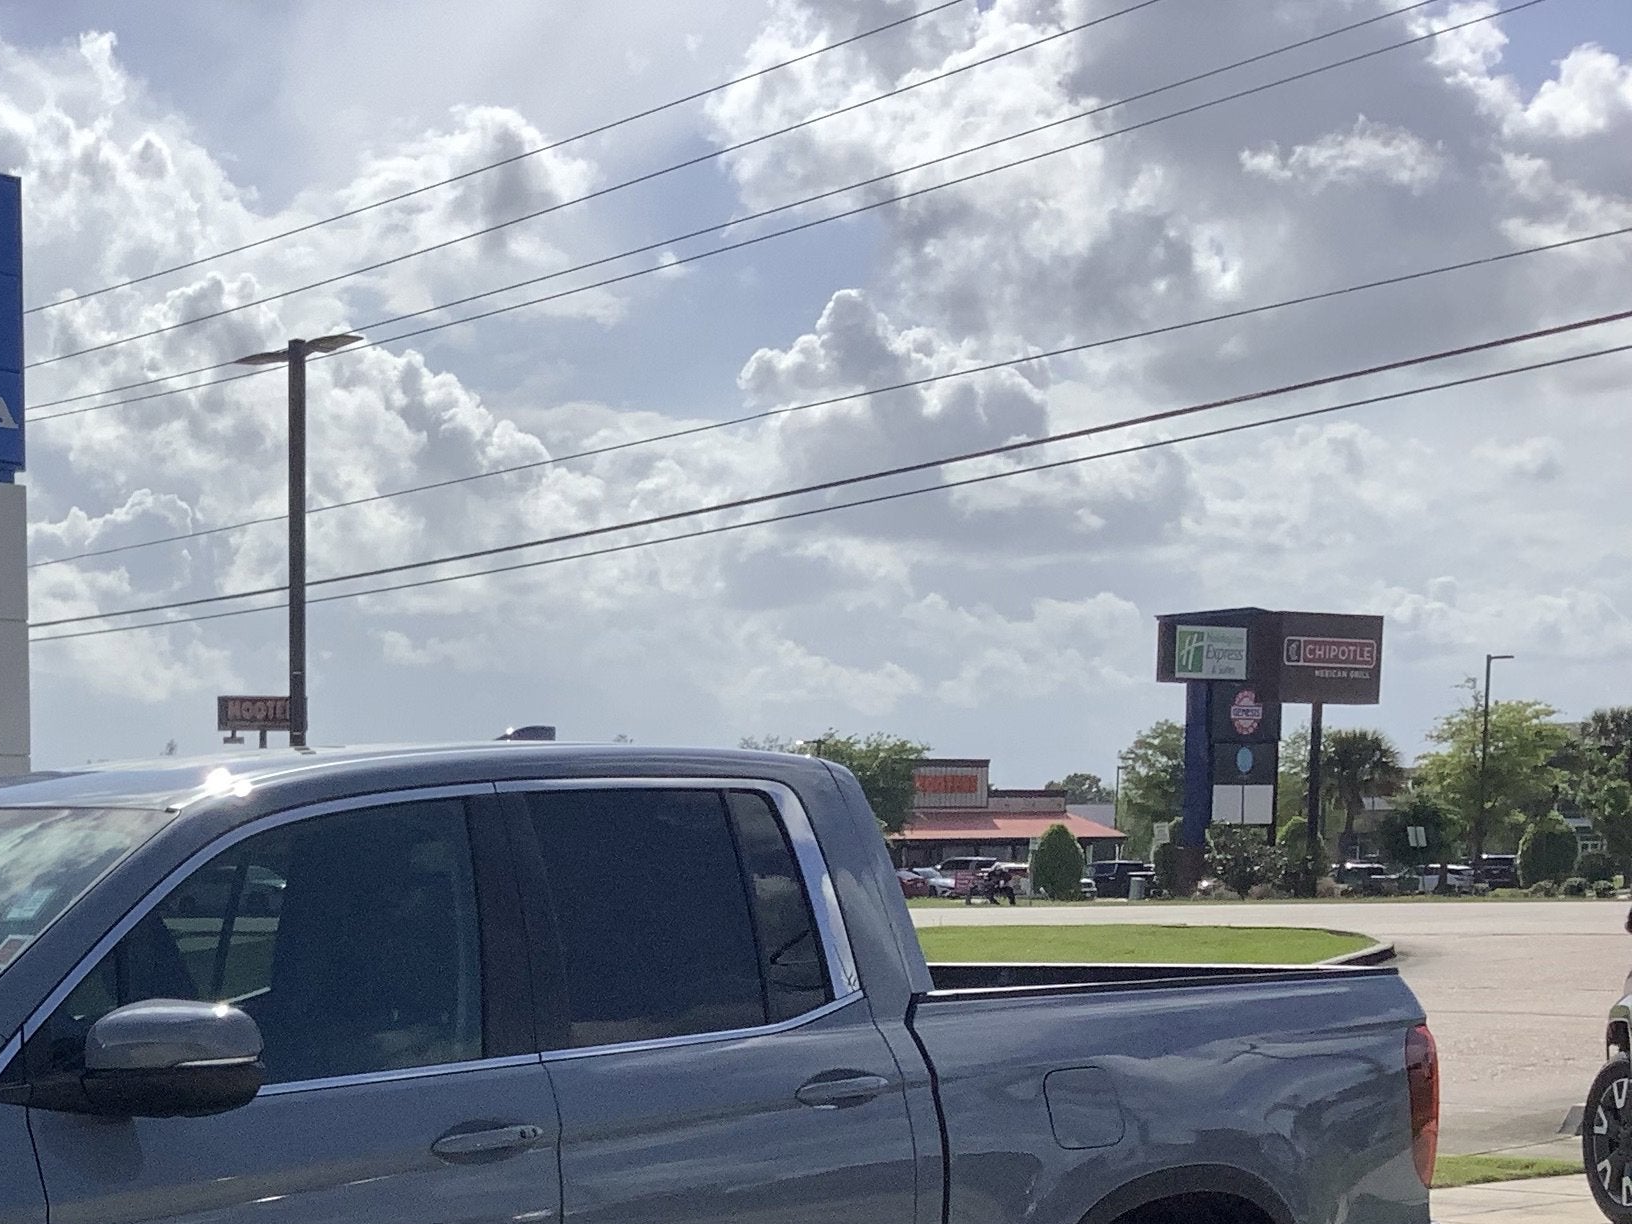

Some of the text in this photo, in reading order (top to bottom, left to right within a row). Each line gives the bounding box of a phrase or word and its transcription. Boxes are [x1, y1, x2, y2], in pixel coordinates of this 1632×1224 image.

[1206, 644, 1244, 664] Express
[1305, 644, 1372, 662] CHIPOTLE
[228, 699, 290, 720] HOOTE
